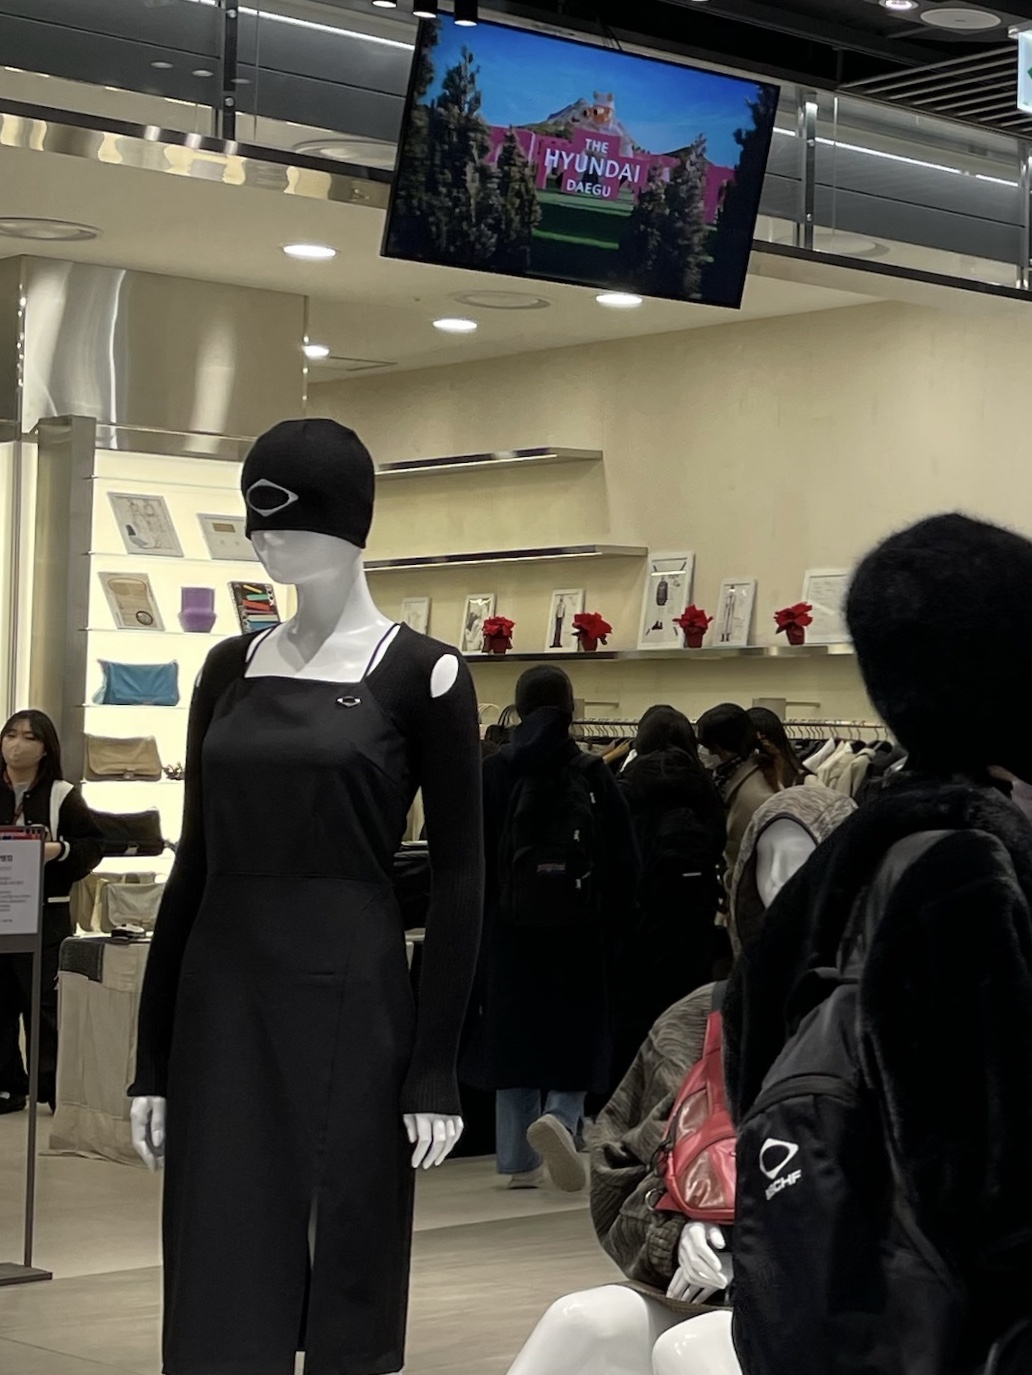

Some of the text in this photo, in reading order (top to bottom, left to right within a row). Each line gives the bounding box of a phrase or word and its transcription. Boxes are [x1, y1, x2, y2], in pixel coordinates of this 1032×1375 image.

[585, 138, 609, 154] THE
[544, 148, 640, 183] HYUNDAI
[566, 179, 611, 198] DAEGU
